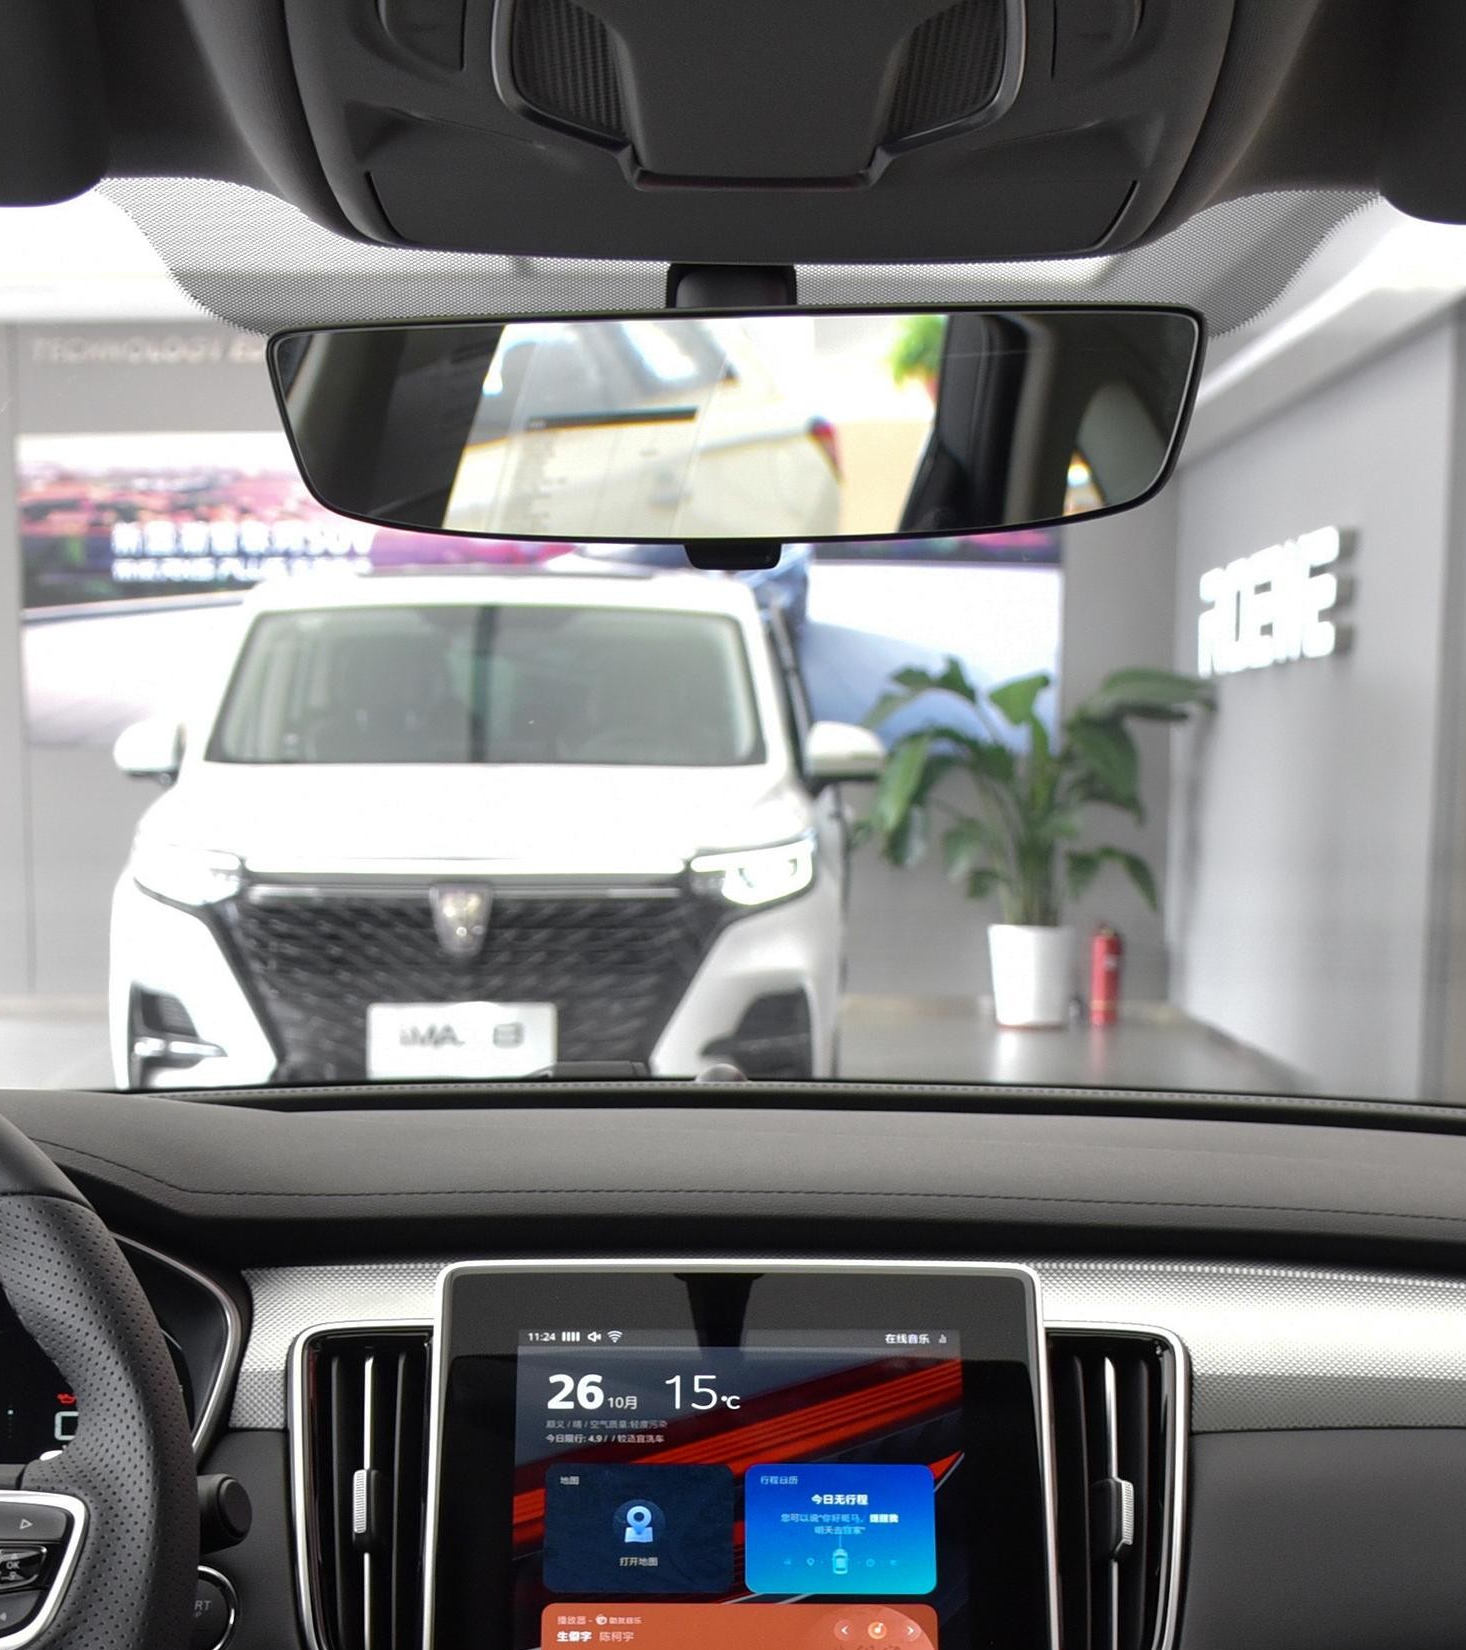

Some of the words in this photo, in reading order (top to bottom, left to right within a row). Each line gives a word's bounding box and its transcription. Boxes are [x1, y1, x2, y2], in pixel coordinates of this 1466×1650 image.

[528, 1332, 556, 1342] 11:24
[885, 1333, 930, 1344] 在线音乐
[547, 1373, 605, 1410] 26
[607, 1395, 638, 1410] 10月
[560, 1475, 580, 1486] 地图
[760, 1475, 799, 1485] 行程日历
[811, 1494, 869, 1506] 今日无行程
[6, 1560, 20, 1570] OK
[619, 1557, 658, 1567] 打开地图
